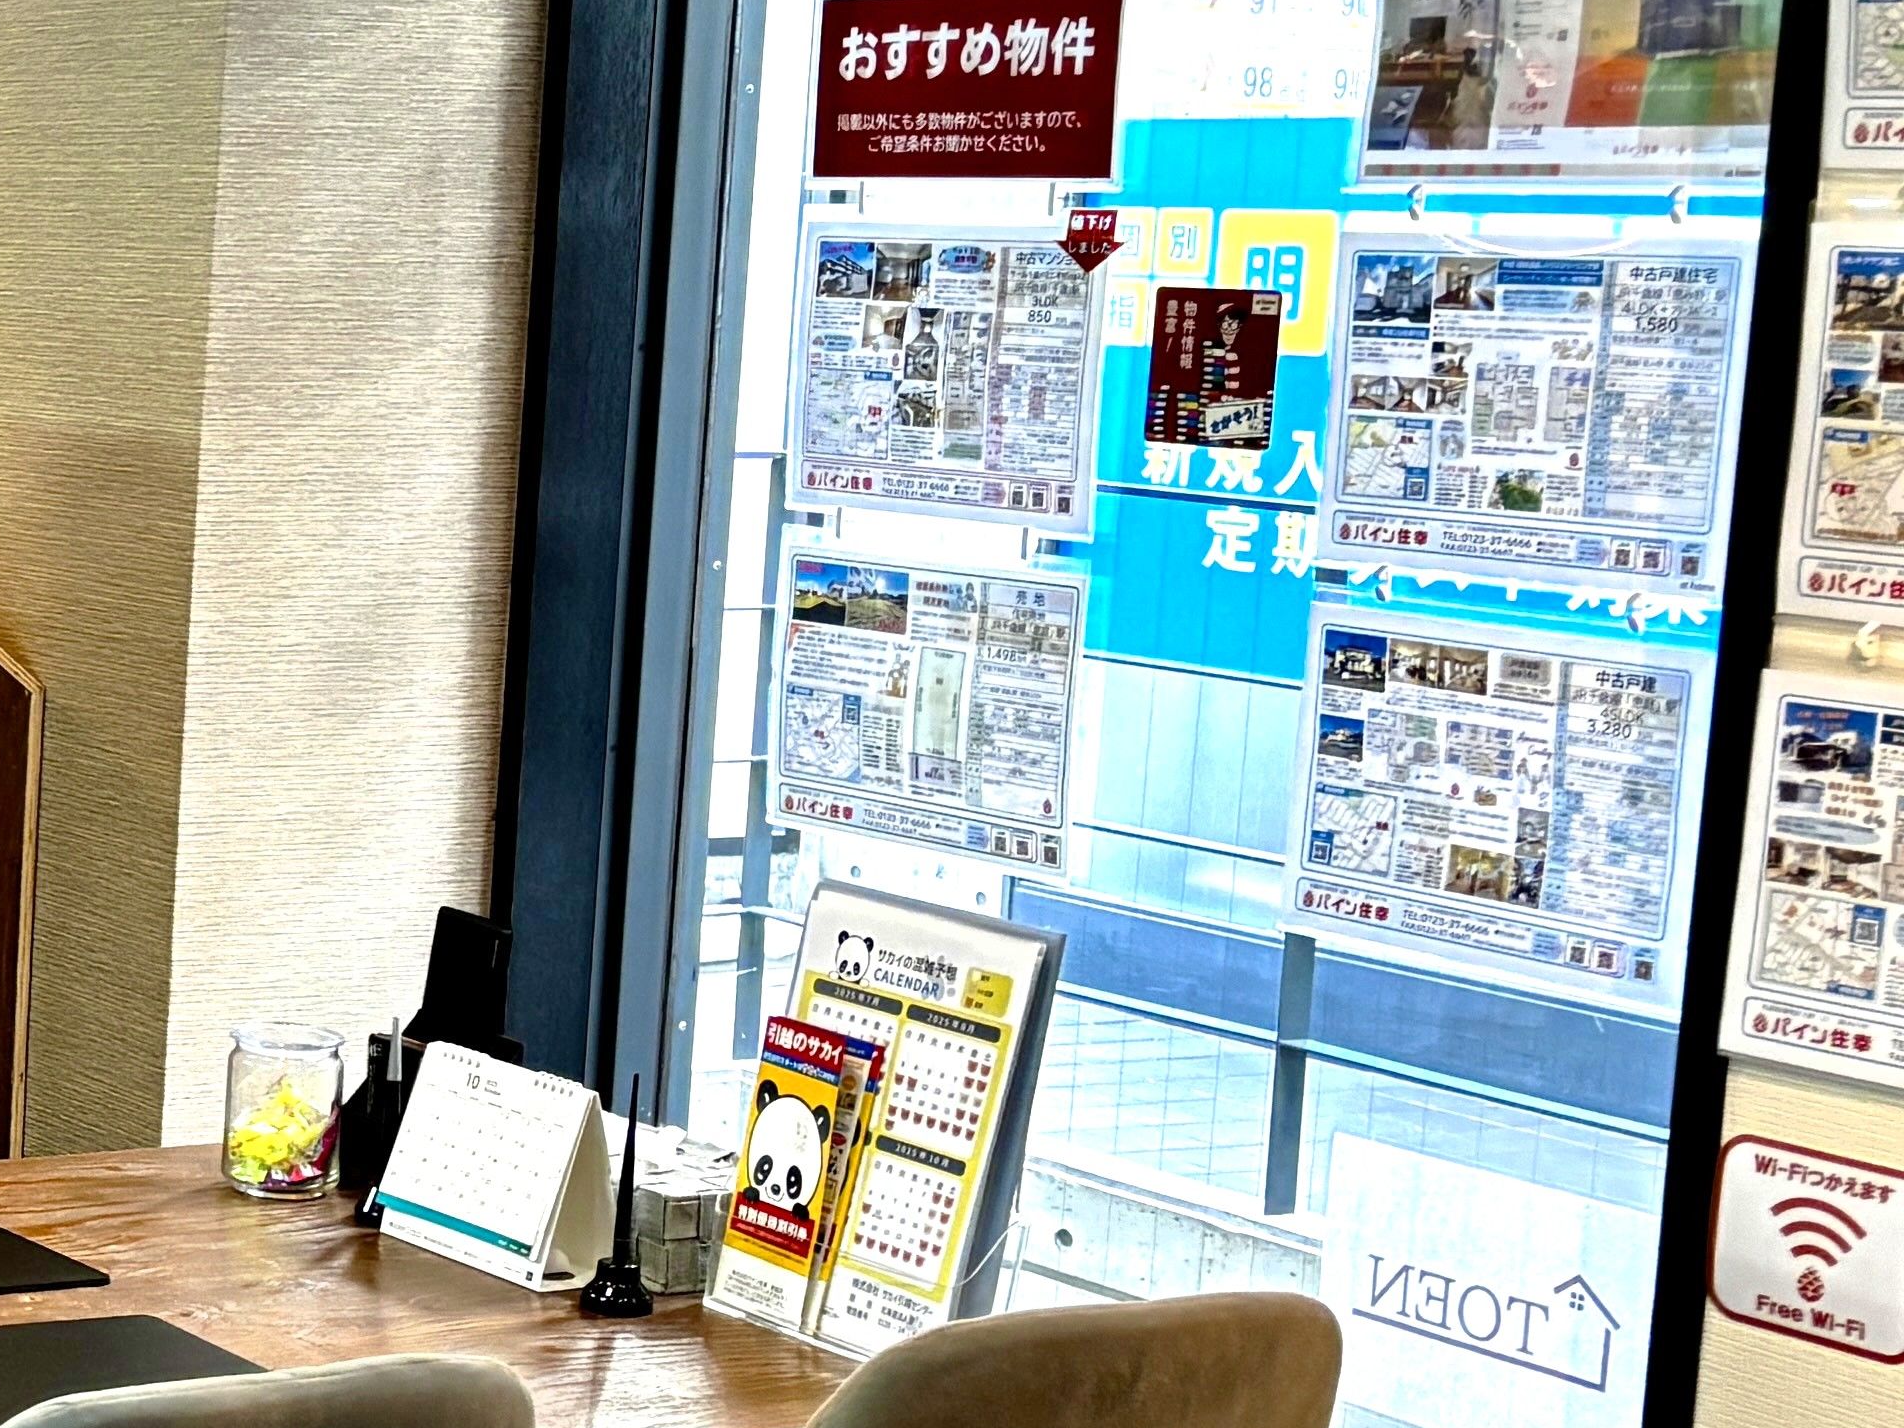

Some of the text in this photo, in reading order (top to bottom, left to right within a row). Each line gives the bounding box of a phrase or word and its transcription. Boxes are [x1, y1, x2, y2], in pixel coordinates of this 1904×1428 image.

[839, 16, 1096, 81] おすすめ物件
[868, 134, 1046, 154] ご希望条件お聞かせください。
[1068, 240, 1112, 255] しました
[1629, 266, 1719, 285] 中古戸建住宅
[1028, 310, 1052, 323] 850
[1636, 316, 1679, 333] 1,580
[1179, 299, 1198, 369] 物件情報
[1352, 523, 1428, 546] パイン住幸
[1595, 669, 1658, 694] 中古戸建
[1587, 719, 1633, 739] 3,280
[1317, 893, 1390, 921] パイン住幸
[874, 968, 940, 997] CALENDAR
[768, 1021, 843, 1066] 引越のサカイ
[1771, 1017, 1873, 1052] パイン住幸
[466, 1073, 481, 1090] 10
[1754, 1153, 1897, 1204] Wi-Fiつかえます
[1756, 1293, 1866, 1341] Free Wi-Fi
